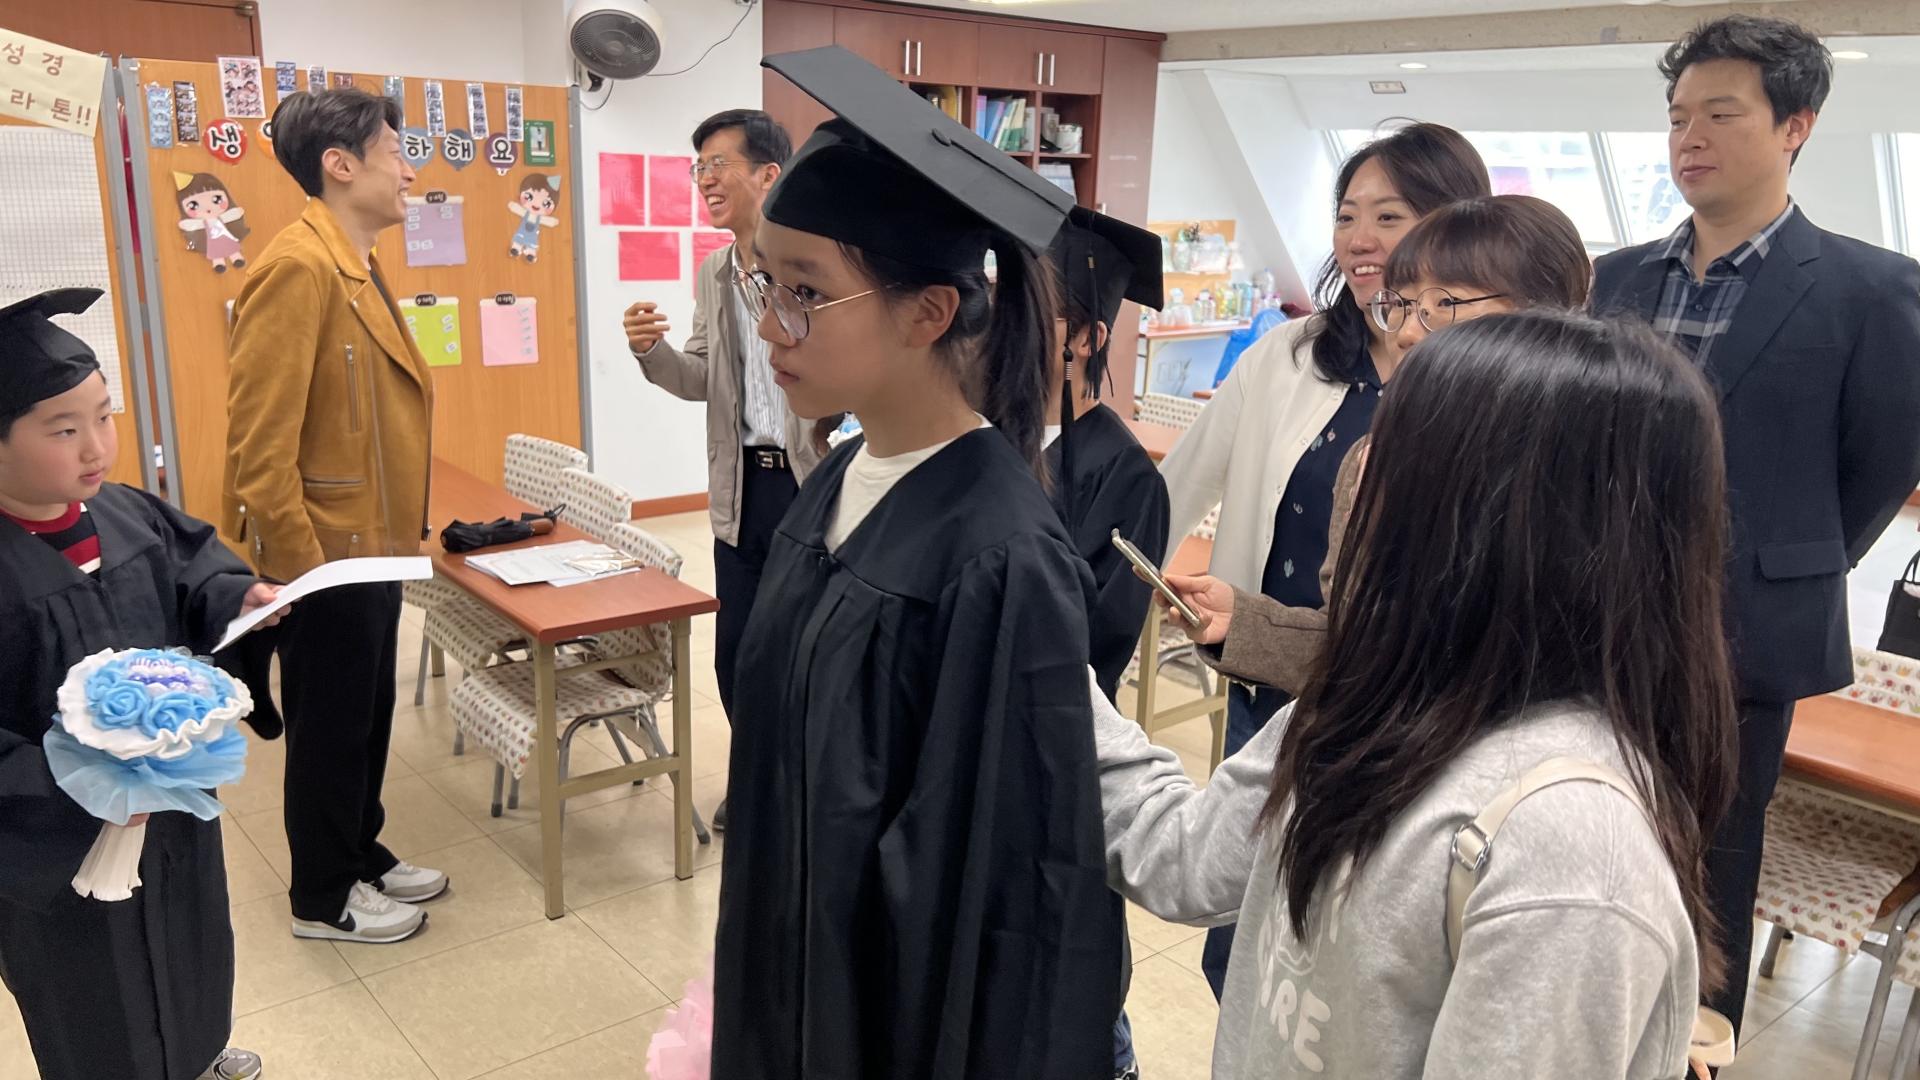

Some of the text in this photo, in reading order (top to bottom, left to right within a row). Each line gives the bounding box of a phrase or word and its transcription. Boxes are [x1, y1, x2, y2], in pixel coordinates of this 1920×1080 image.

[3, 43, 64, 77] 성 경
[10, 89, 91, 127] 라 톤!!
[210, 124, 240, 156] 생
[404, 136, 433, 159] 하
[446, 136, 472, 159] 해
[491, 140, 515, 161] 요
